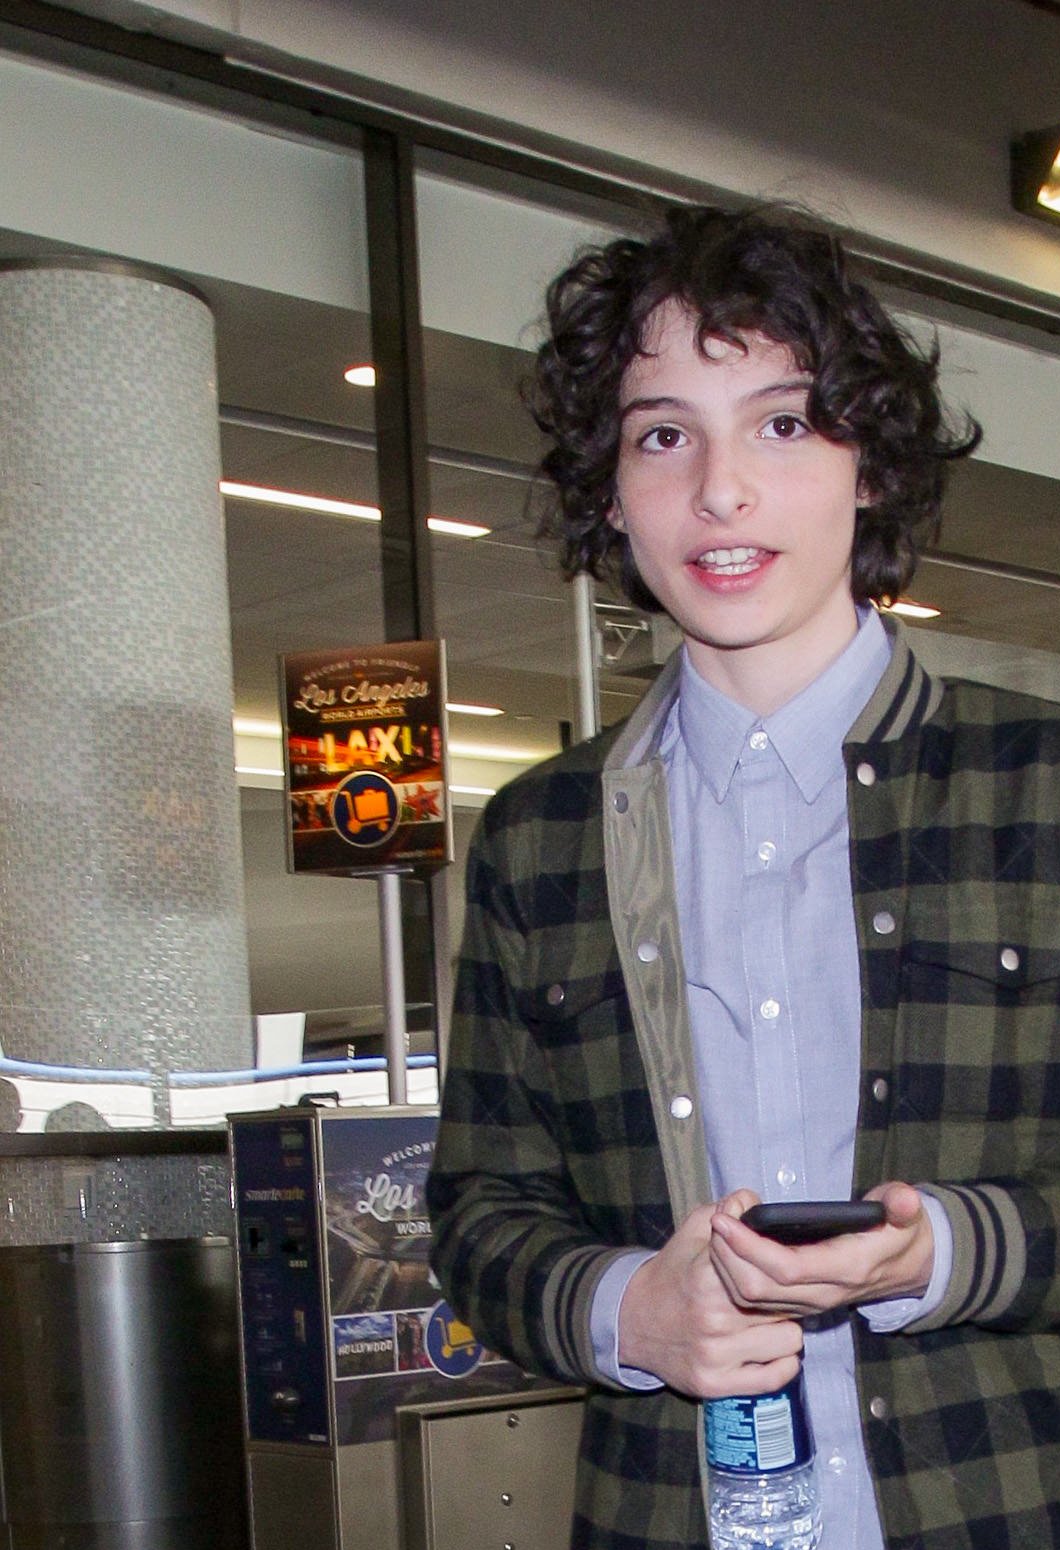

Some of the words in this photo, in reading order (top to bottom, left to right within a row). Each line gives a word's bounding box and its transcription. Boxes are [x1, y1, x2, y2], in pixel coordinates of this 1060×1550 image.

[294, 683, 337, 714] Los
[341, 676, 431, 710] Angeles
[356, 1172, 418, 1222] Los
[338, 1339, 393, 1357] HOLLYWOOD
